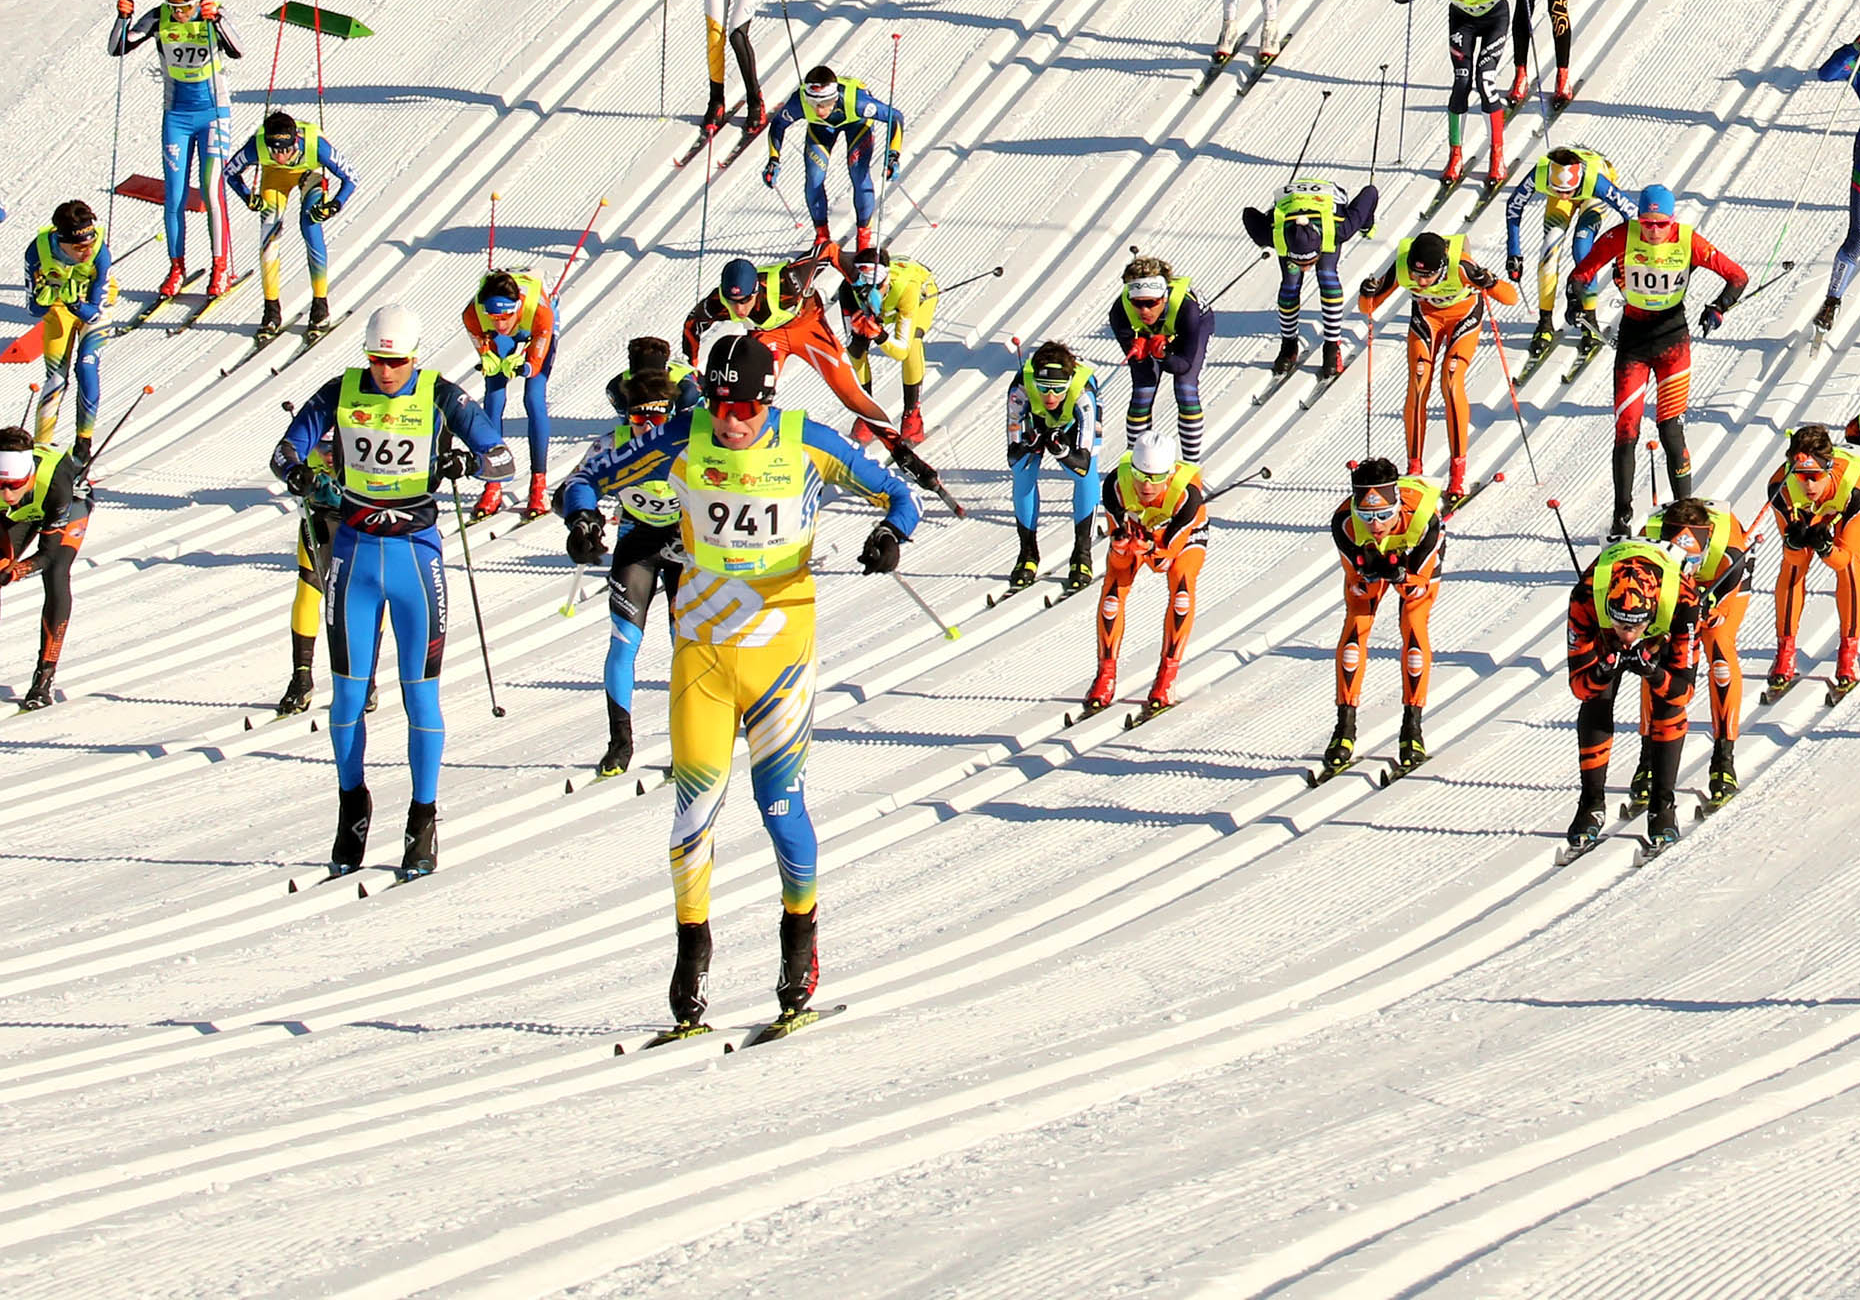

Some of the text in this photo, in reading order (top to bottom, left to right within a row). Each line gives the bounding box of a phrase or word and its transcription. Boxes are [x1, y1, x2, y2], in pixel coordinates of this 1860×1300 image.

[173, 47, 208, 63] 979
[1631, 271, 1685, 289] 1014
[710, 370, 740, 385] DNB
[355, 436, 415, 466] 962
[632, 493, 680, 512] 995
[708, 501, 779, 537] 941
[430, 557, 447, 634] CATALUNYA
